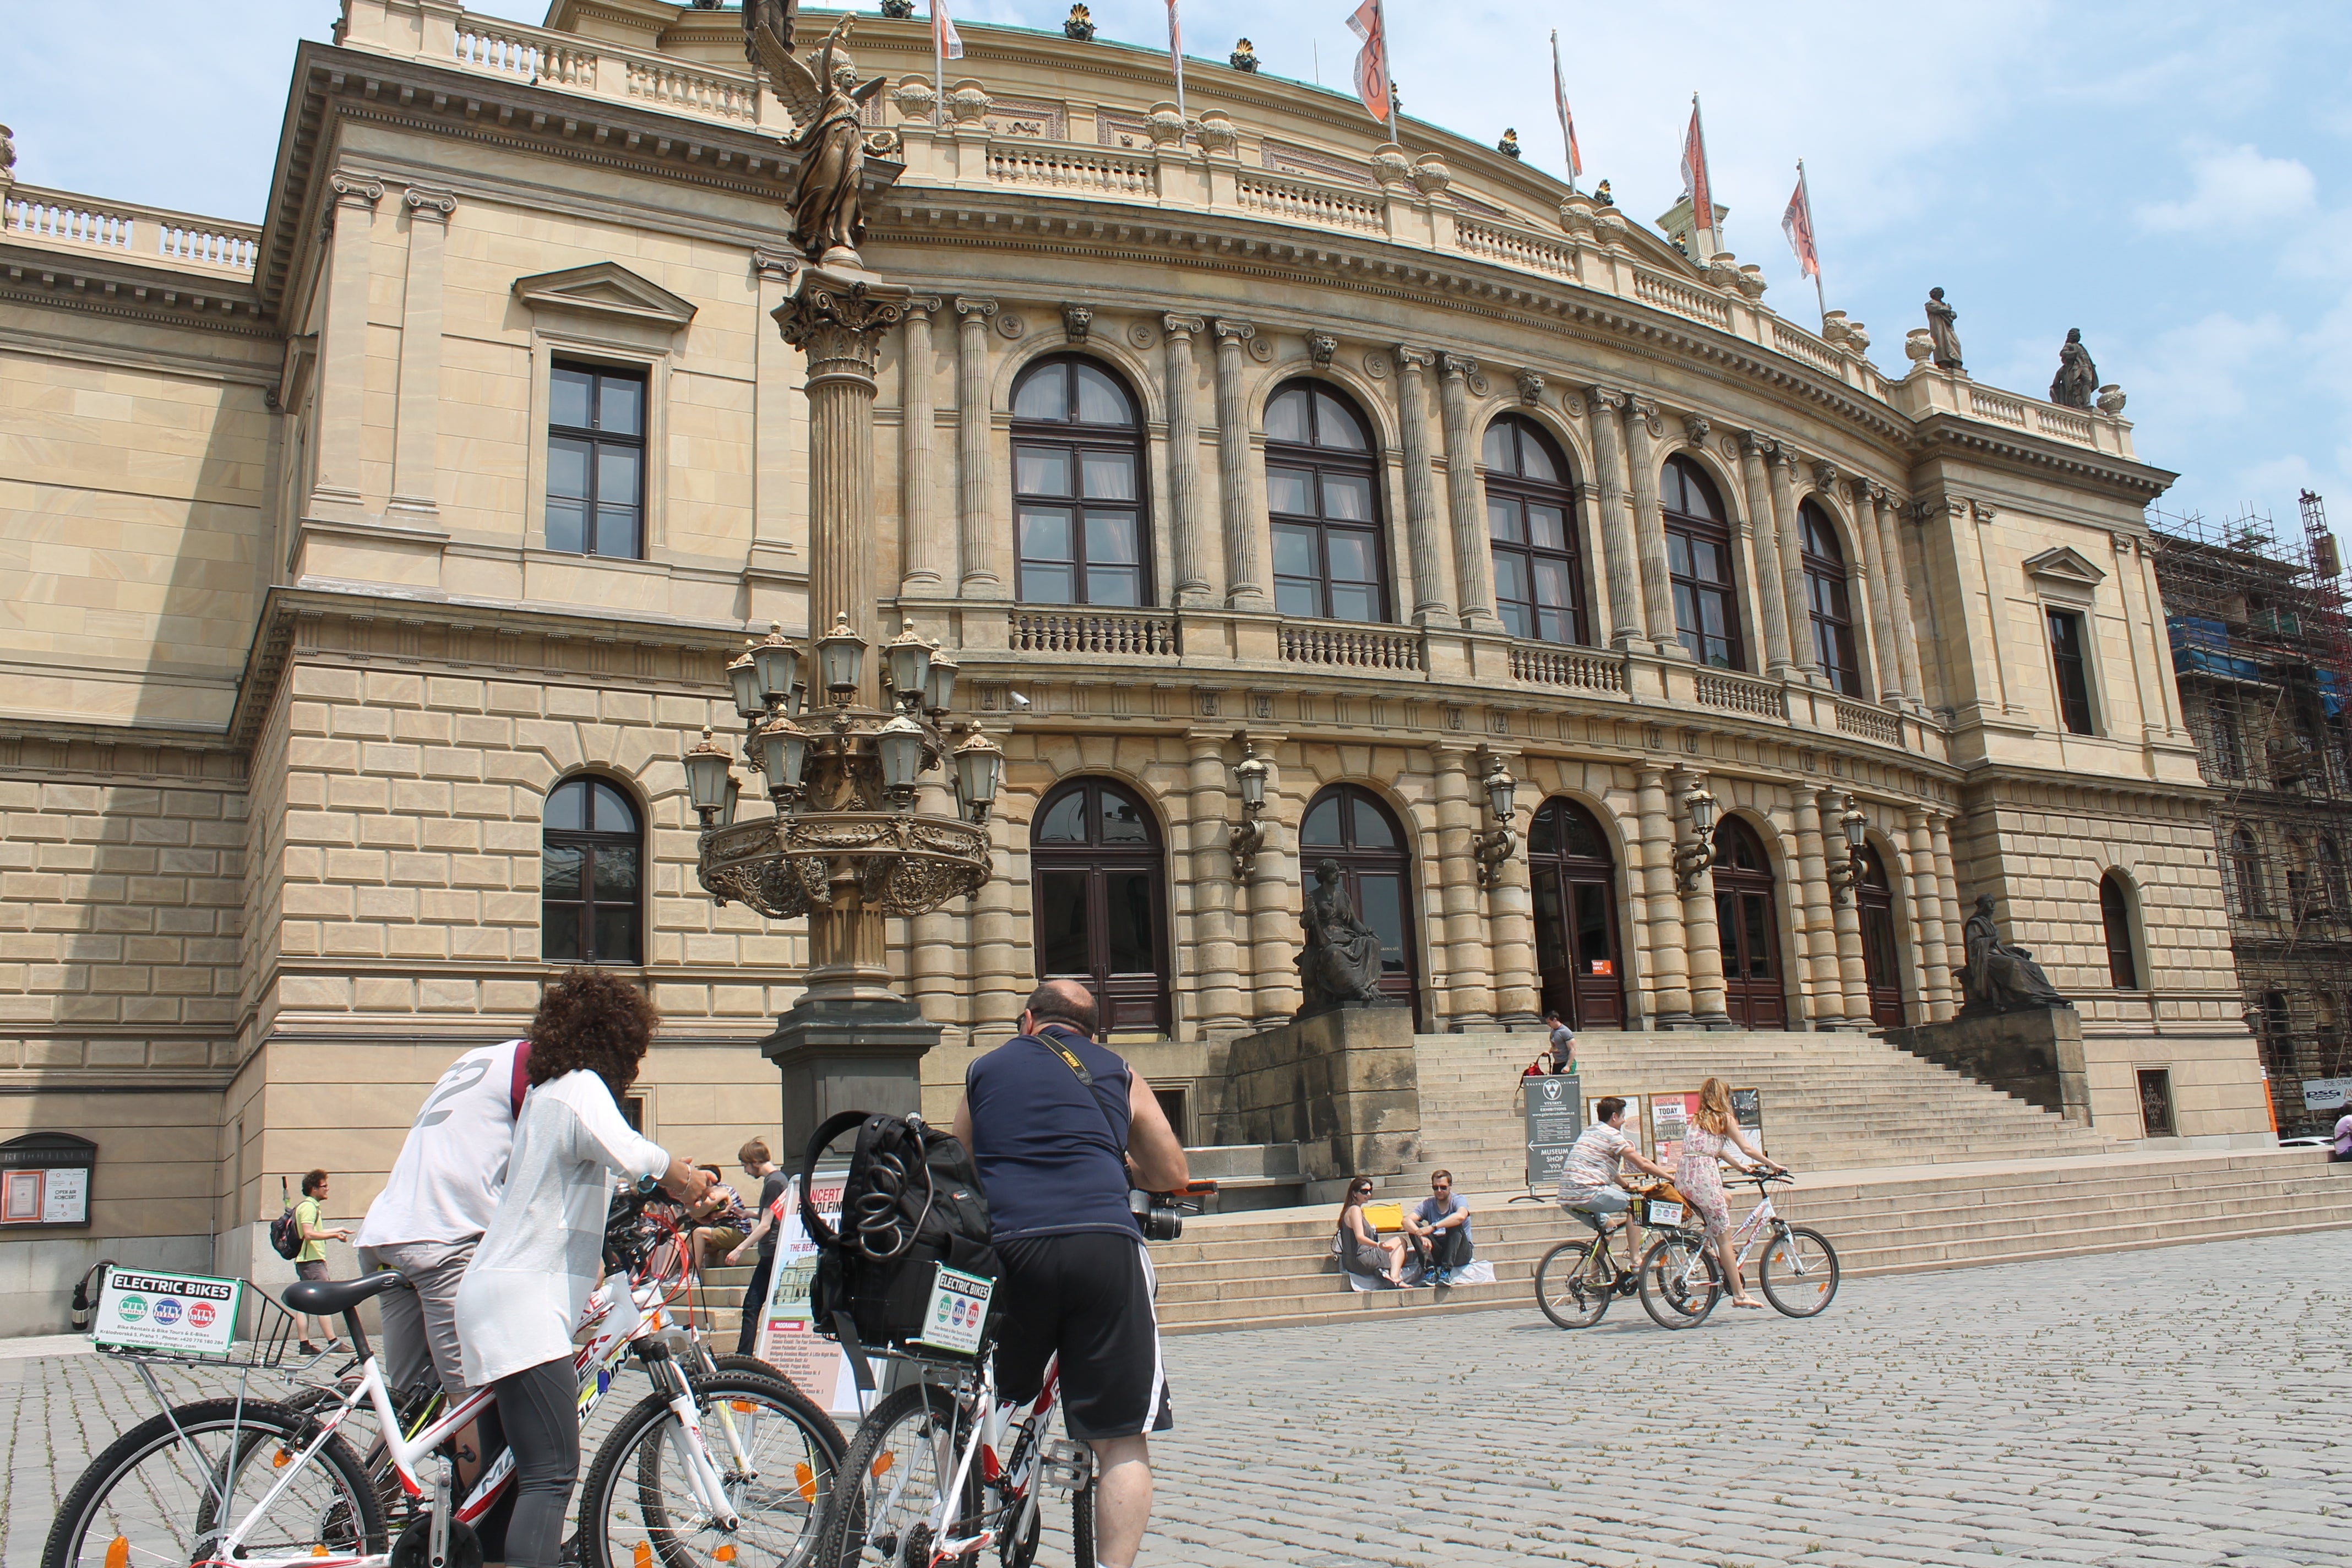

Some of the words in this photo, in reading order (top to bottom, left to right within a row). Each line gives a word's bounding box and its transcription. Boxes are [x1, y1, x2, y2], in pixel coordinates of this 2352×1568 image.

[1062, 1051, 1080, 1067] Nikon
[802, 1243, 816, 1251] BEST
[114, 1276, 182, 1293] ELECTRIC
[186, 1283, 228, 1298] BIKES
[940, 1276, 970, 1294] ELECTRIC
[970, 1283, 988, 1298] BIKES
[120, 1300, 147, 1311] CITY
[155, 1304, 182, 1315] CITY
[189, 1308, 215, 1318] CITY
[968, 1308, 978, 1317] CITY
